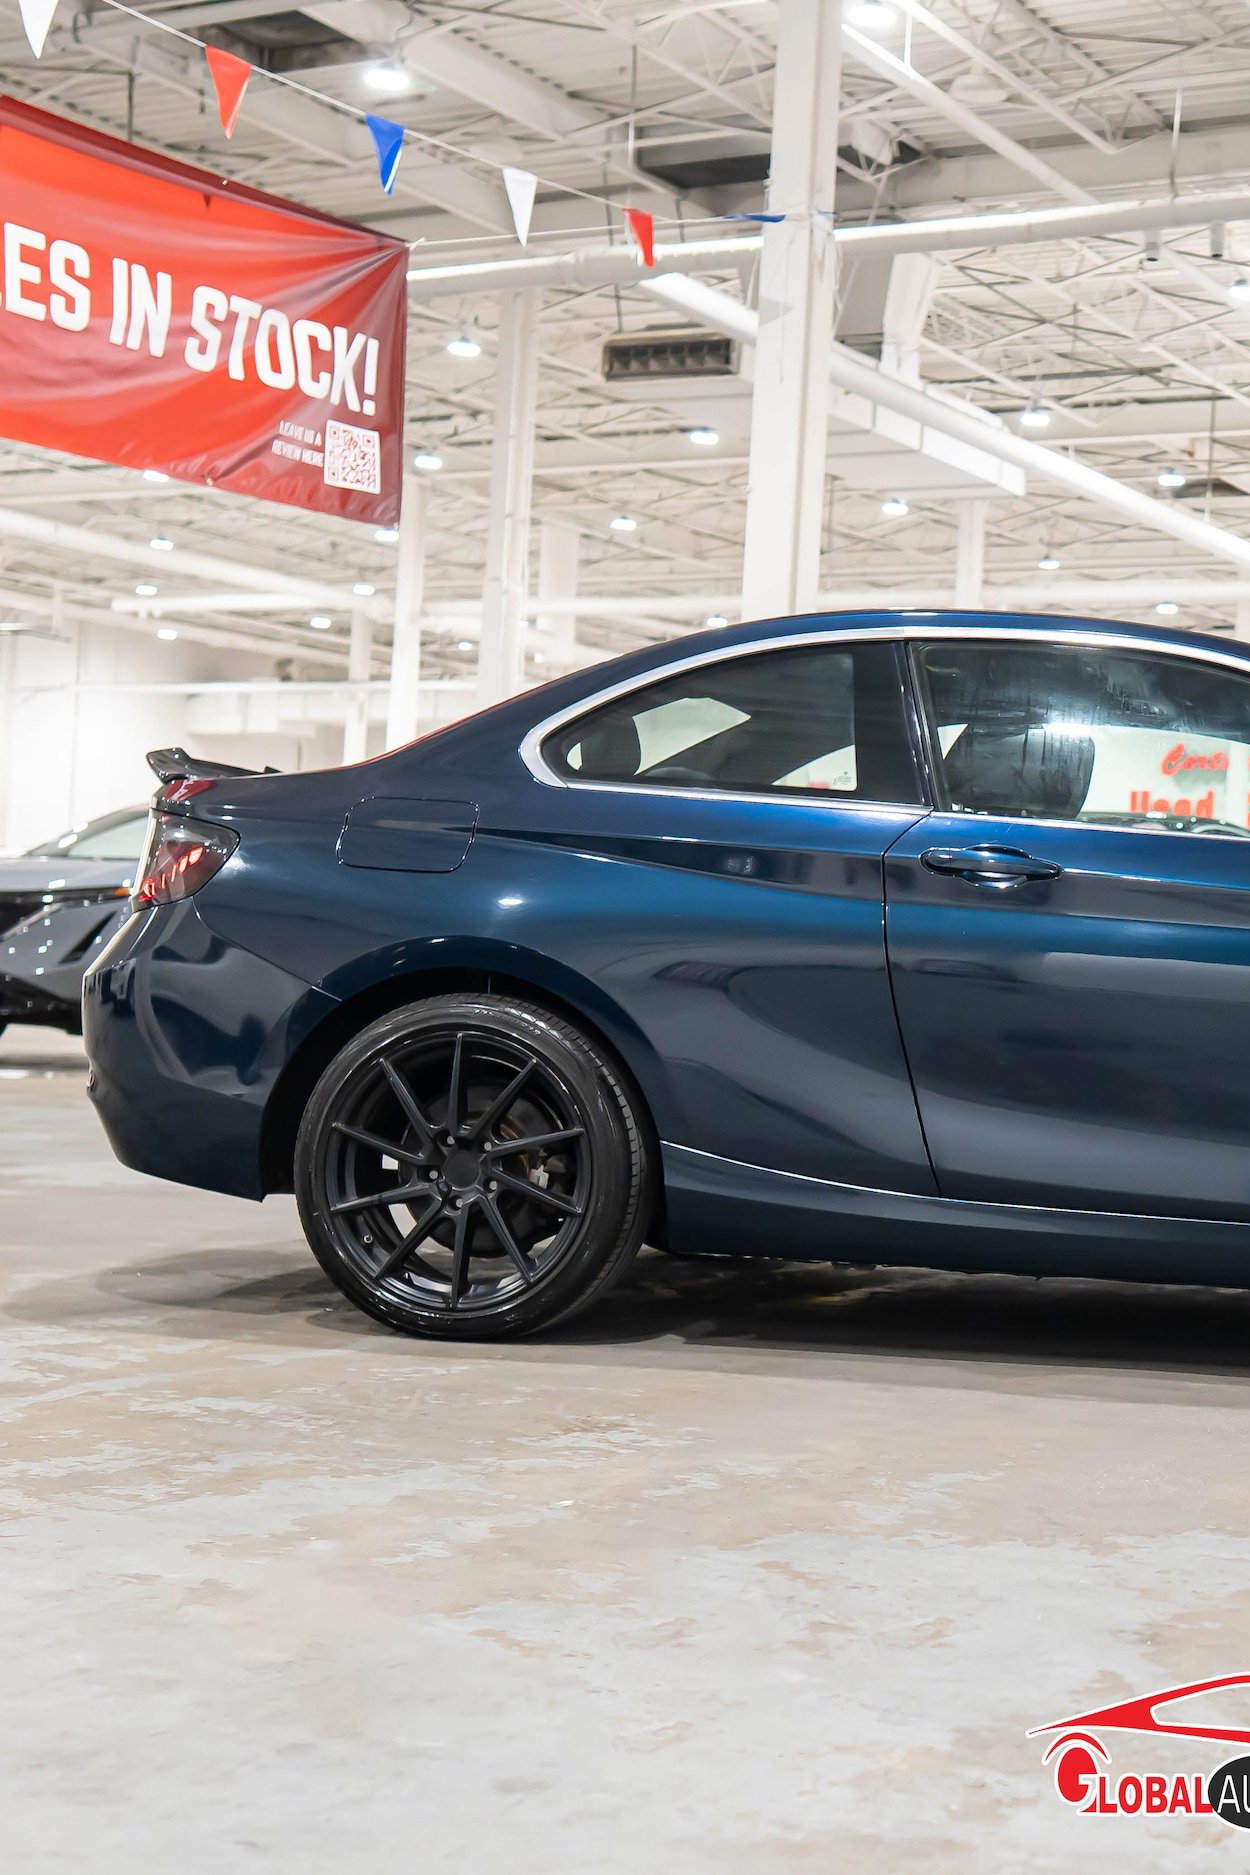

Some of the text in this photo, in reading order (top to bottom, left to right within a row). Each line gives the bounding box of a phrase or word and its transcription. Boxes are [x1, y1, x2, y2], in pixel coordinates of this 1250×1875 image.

[0, 221, 380, 416] ES IN STOCK!
[279, 420, 305, 441] LEAVE
[271, 439, 325, 468] REVIEW HERE
